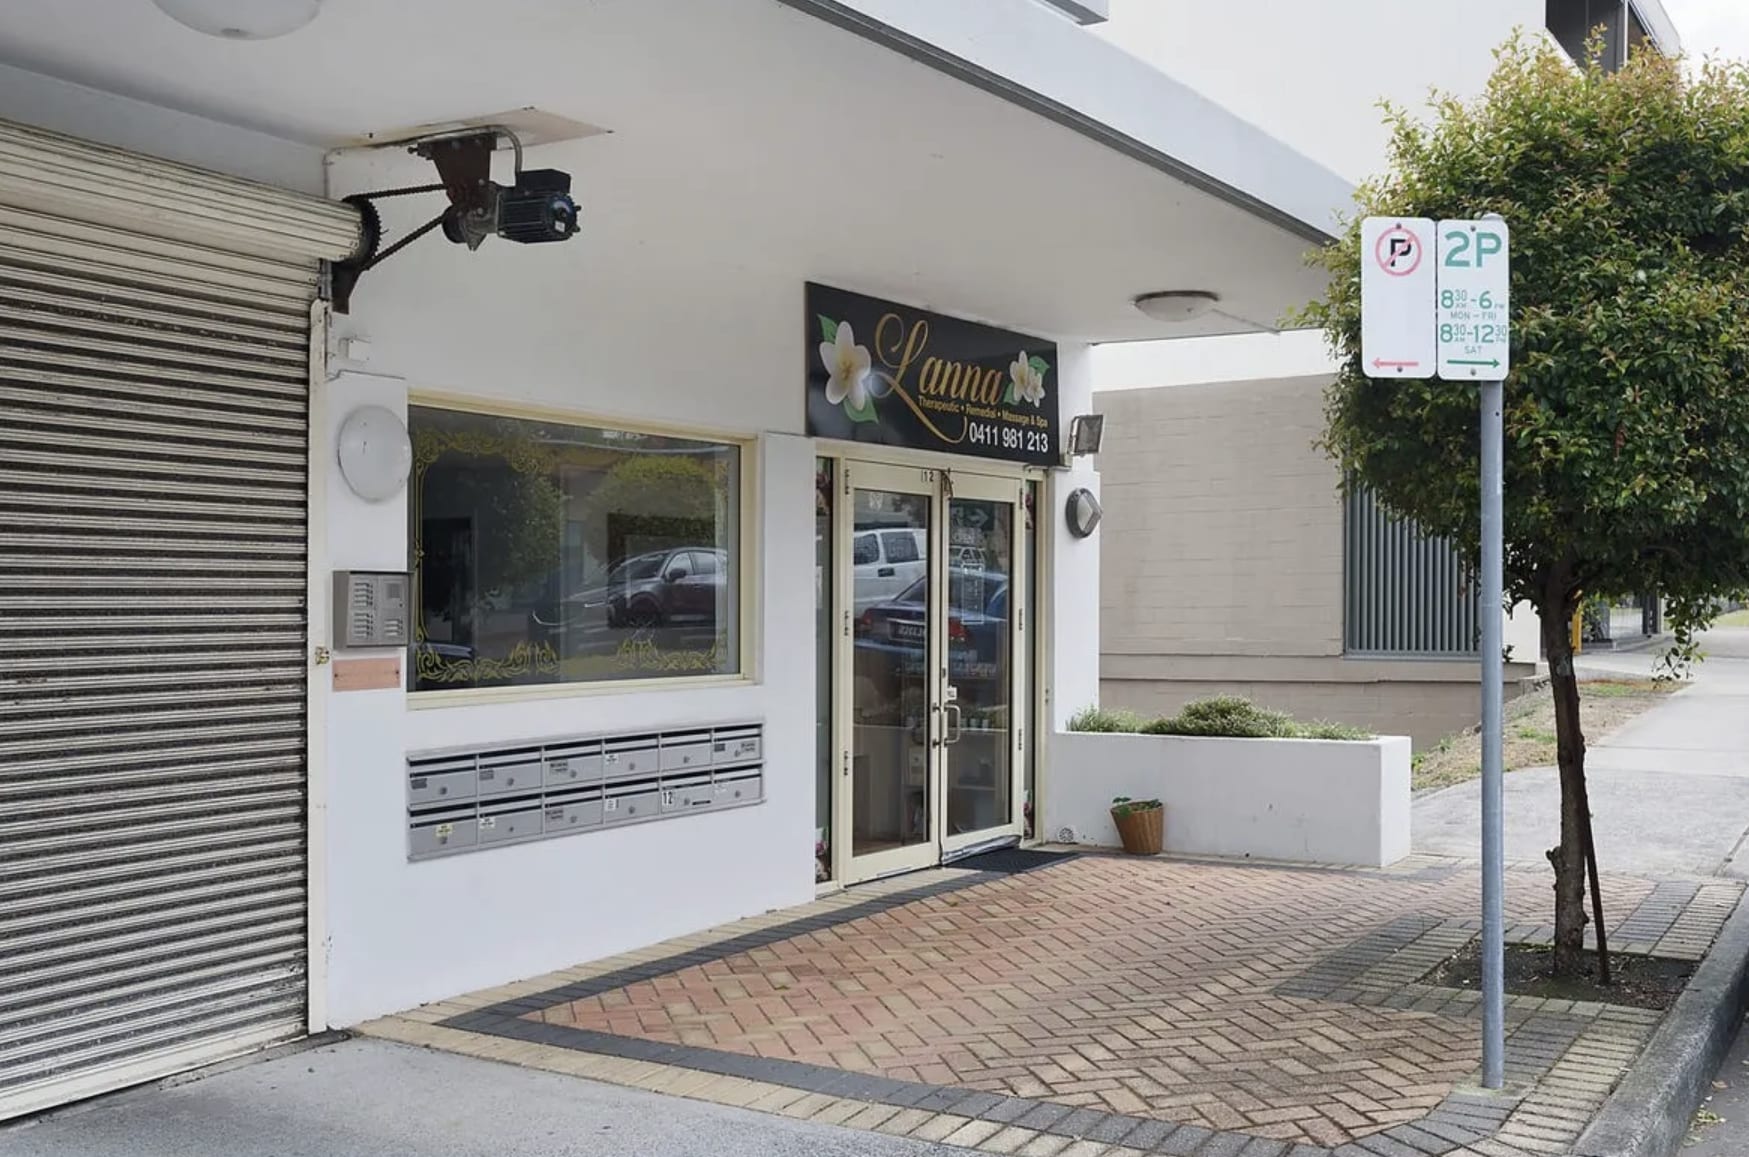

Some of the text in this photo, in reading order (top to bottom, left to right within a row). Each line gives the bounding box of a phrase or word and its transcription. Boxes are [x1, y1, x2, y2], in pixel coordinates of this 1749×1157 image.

[1390, 238, 1412, 267] P
[1444, 231, 1502, 268] 2P
[1450, 311, 1470, 319] MON
[1464, 345, 1482, 354] SAT
[868, 313, 1003, 443] Lanna
[1002, 409, 1030, 426] Massage
[968, 422, 1049, 453] 0411 981 213
